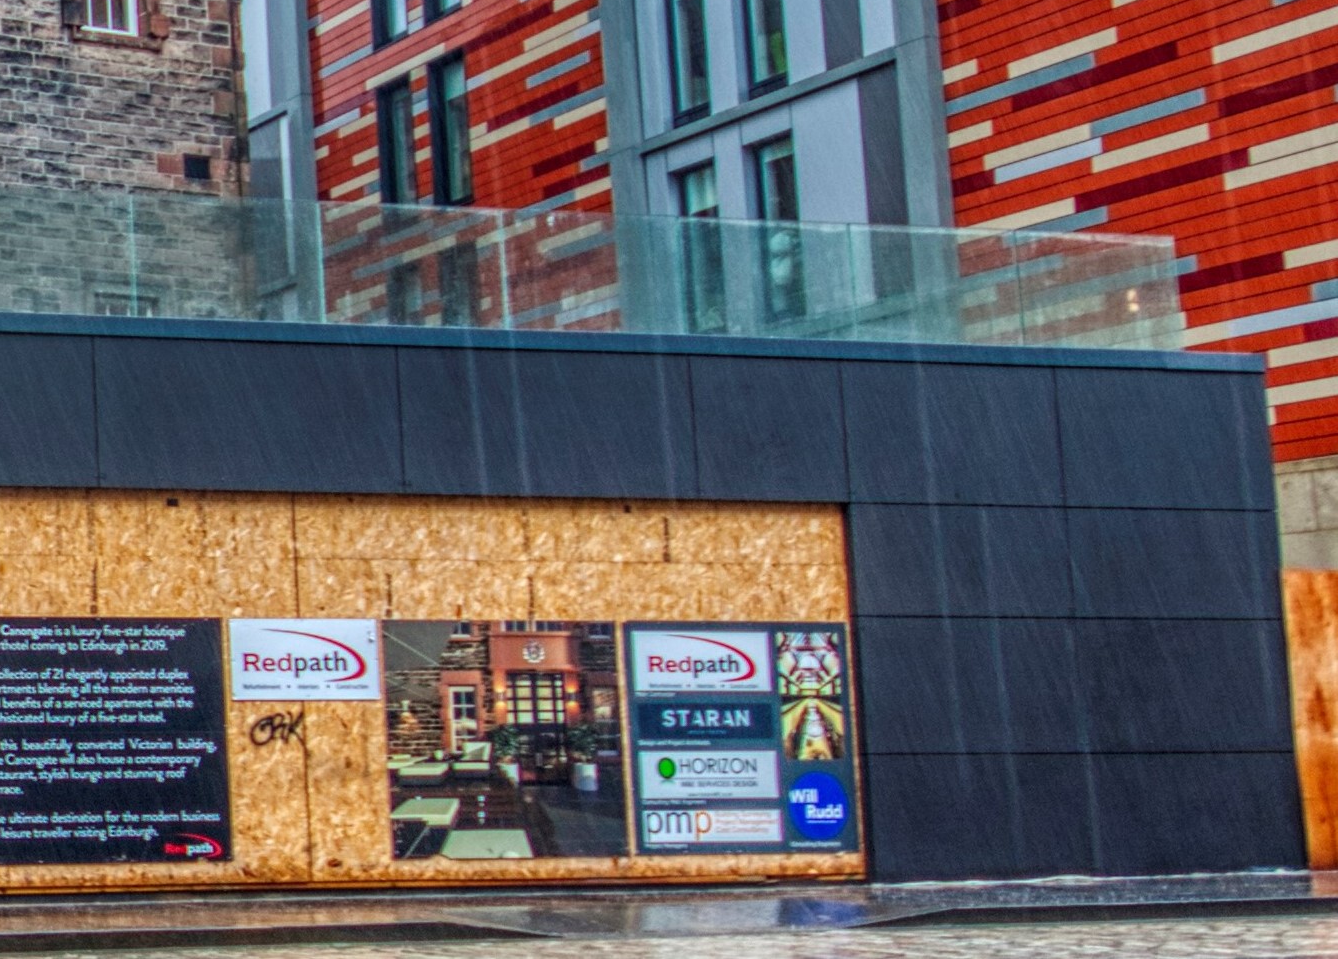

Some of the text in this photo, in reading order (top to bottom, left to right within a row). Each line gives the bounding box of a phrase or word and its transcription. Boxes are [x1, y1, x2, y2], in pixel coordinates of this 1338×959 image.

[0, 624, 53, 640] Canongate
[54, 624, 63, 636] is
[71, 625, 102, 640] luxury
[103, 624, 142, 636] five-star
[143, 625, 186, 640] boutique
[29, 639, 67, 655] coming
[67, 641, 79, 651] to
[80, 639, 128, 655] Edinburgh
[129, 640, 139, 651] in
[140, 640, 168, 651] 2019.
[241, 651, 348, 678] Redpath
[647, 655, 740, 678] Redpath
[39, 668, 51, 679] of
[51, 668, 63, 679] 21
[65, 668, 108, 683] elegantly
[109, 668, 156, 683] appointed
[157, 668, 189, 683] duplex
[37, 683, 79, 698] blending
[80, 683, 91, 694] all
[92, 683, 109, 694] the
[110, 683, 148, 694] modern
[149, 683, 195, 694] amenities
[2, 697, 41, 708] benefits
[43, 697, 54, 708] of
[63, 697, 103, 708] serviced
[104, 699, 153, 712] apartment
[155, 697, 175, 708] with
[176, 697, 194, 708] the
[46, 711, 76, 727] luxury
[77, 711, 89, 723] of
[89, 715, 97, 723] a
[97, 711, 137, 723] five-star
[137, 711, 166, 723] hotel.
[661, 709, 751, 728] STARAN
[0, 739, 19, 751] this
[21, 739, 73, 753] beautifully
[75, 739, 125, 750] converted
[128, 738, 173, 749] Victorian
[176, 738, 217, 753] building,
[5, 753, 58, 769] Canongate
[59, 753, 75, 764] will
[77, 753, 95, 764] also
[96, 753, 125, 764] house
[135, 755, 201, 767] contemporary
[679, 758, 758, 774] HORIZON
[38, 768, 69, 783] stylish
[69, 768, 103, 783] lounge
[104, 767, 122, 779] and
[123, 767, 164, 783] stunning
[165, 767, 187, 778] roof
[788, 789, 819, 803] Will
[8, 812, 49, 823] ultimate
[50, 811, 103, 823] destination
[104, 810, 120, 822] for
[121, 811, 140, 822] the
[141, 810, 179, 822] modern
[180, 810, 221, 822] business
[805, 803, 844, 819] Rudd
[0, 827, 32, 839] leisure
[33, 827, 72, 839] traveller
[73, 827, 107, 841] visiting
[107, 825, 159, 841] Edinburgh.
[647, 810, 713, 842] pmp
